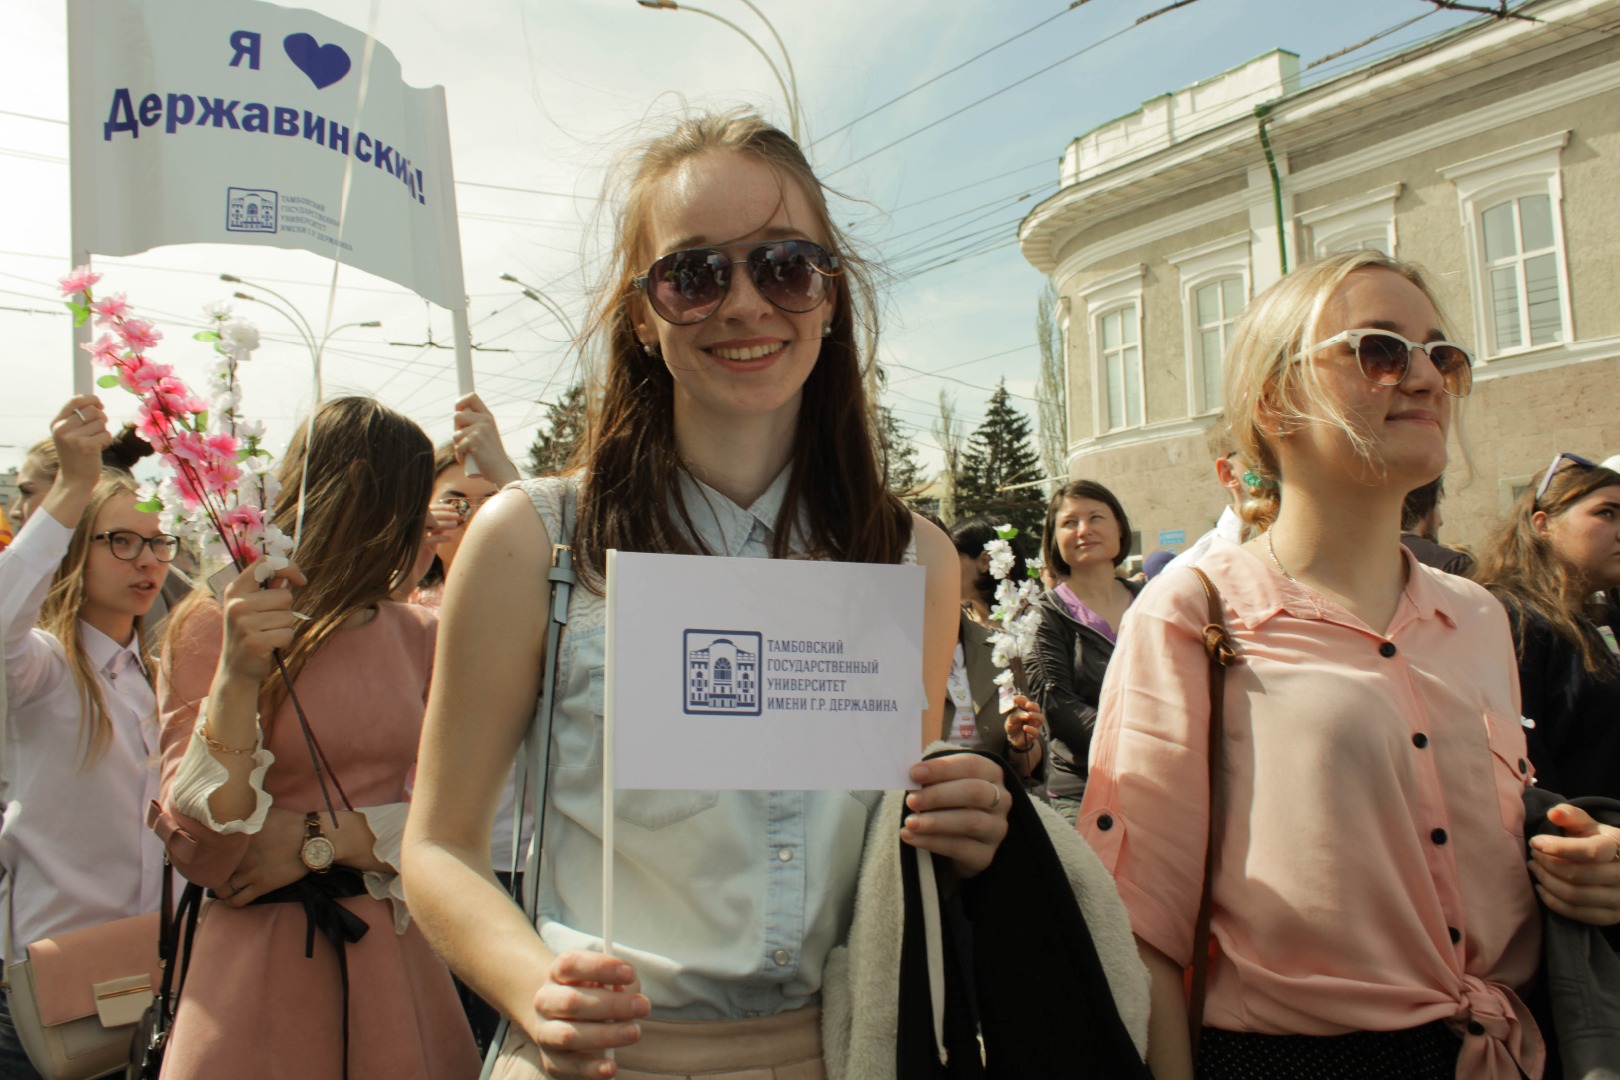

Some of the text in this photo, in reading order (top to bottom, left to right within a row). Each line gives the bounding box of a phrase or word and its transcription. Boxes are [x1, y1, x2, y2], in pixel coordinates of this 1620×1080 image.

[228, 29, 261, 71] Я
[281, 195, 325, 211] ТАМБОВСКИЙ
[281, 206, 340, 227] ГОСУДАРСТВЕННЫ
[767, 639, 844, 655] ТАМБОВСКИЙ
[767, 658, 879, 674] ГОСУДАРСТВЕННЫЙ
[767, 678, 846, 692] УНИВЕРСИТЕТ
[767, 697, 898, 713] ИМЕНИ Г.Р. ДЕРЖАВИНА
